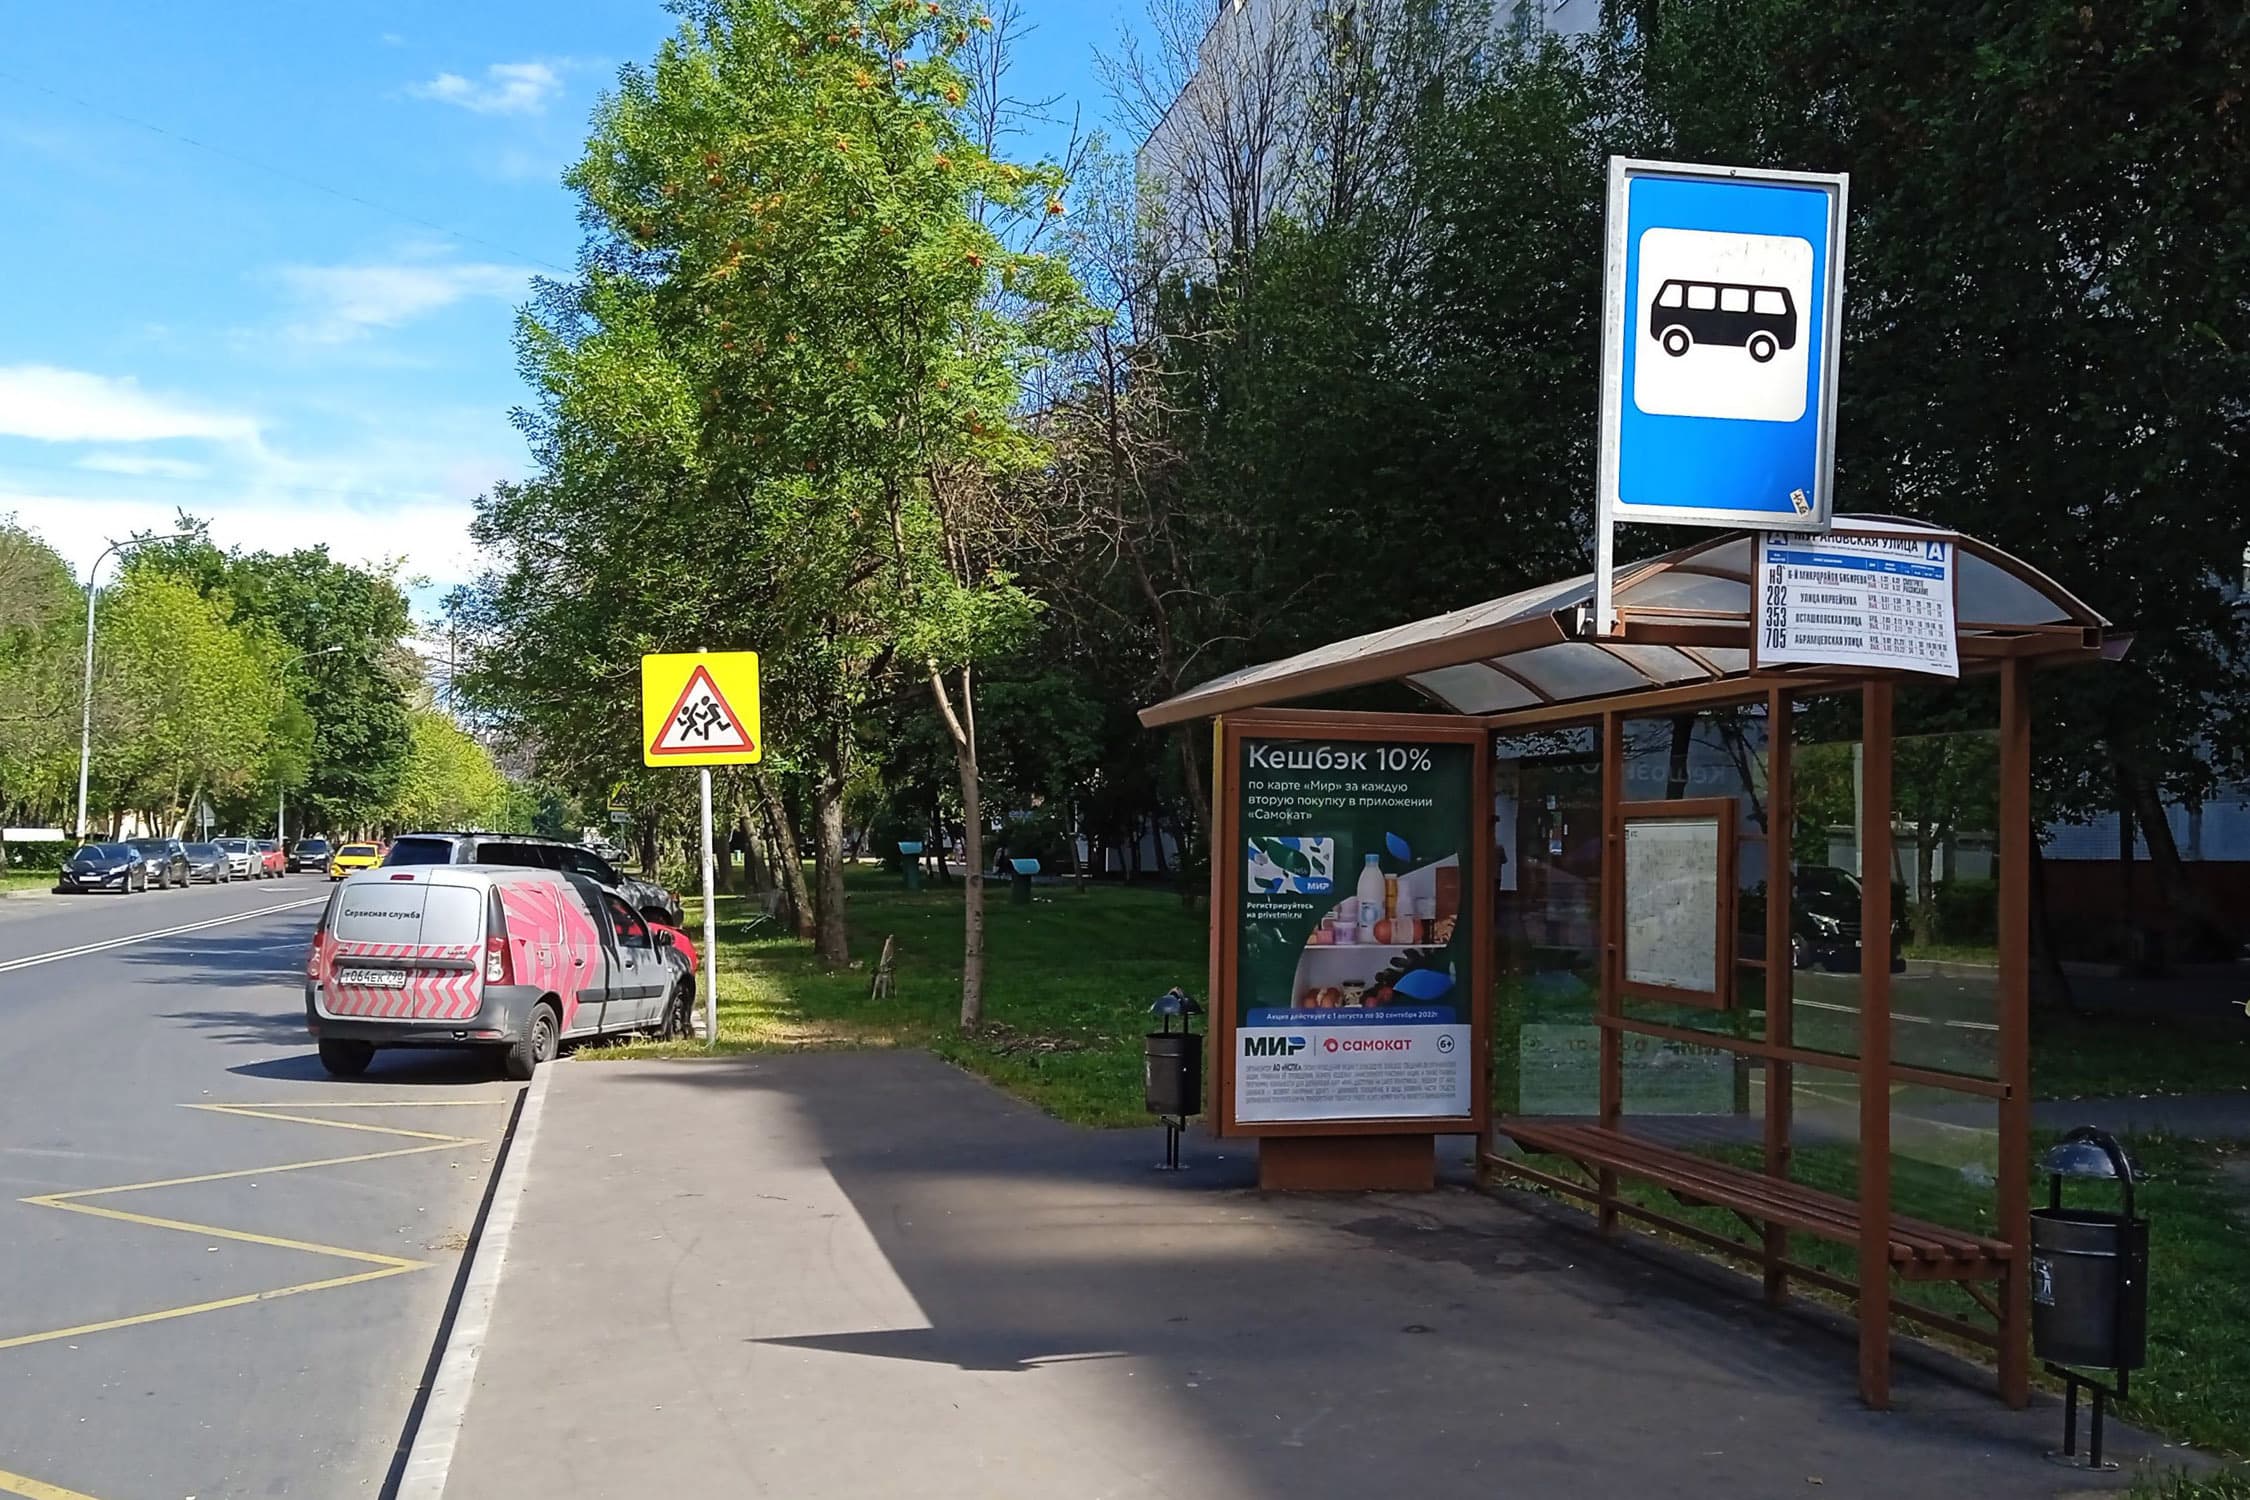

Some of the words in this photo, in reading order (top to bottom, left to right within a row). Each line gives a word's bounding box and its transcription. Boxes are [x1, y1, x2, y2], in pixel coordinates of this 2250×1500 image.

[1882, 538, 1919, 553] УЛИЦА
[1767, 585, 1787, 606] 282
[1766, 607, 1787, 627] 353
[1766, 628, 1787, 648] 705
[1248, 745, 1367, 770] Кешбэк
[1376, 748, 1432, 772] 10%
[1248, 781, 1264, 790] по
[1267, 782, 1301, 793] карте
[1304, 781, 1342, 792] «Мир»
[1345, 784, 1358, 792] за
[1361, 783, 1408, 793] каждую
[1248, 796, 1294, 806] вторую
[1298, 797, 1346, 808] покупку
[1349, 798, 1356, 806] в
[1359, 797, 1433, 808] приложении
[1248, 809, 1312, 821] «Самокат»
[1307, 882, 1330, 891] МИР
[1246, 902, 1314, 911] Регистрируйтесь
[344, 909, 387, 918] Сервисная
[388, 910, 421, 921] служба
[1244, 1036, 1306, 1057] МИР
[1342, 1038, 1413, 1052] самокат
[1439, 1040, 1453, 1049] 6+
